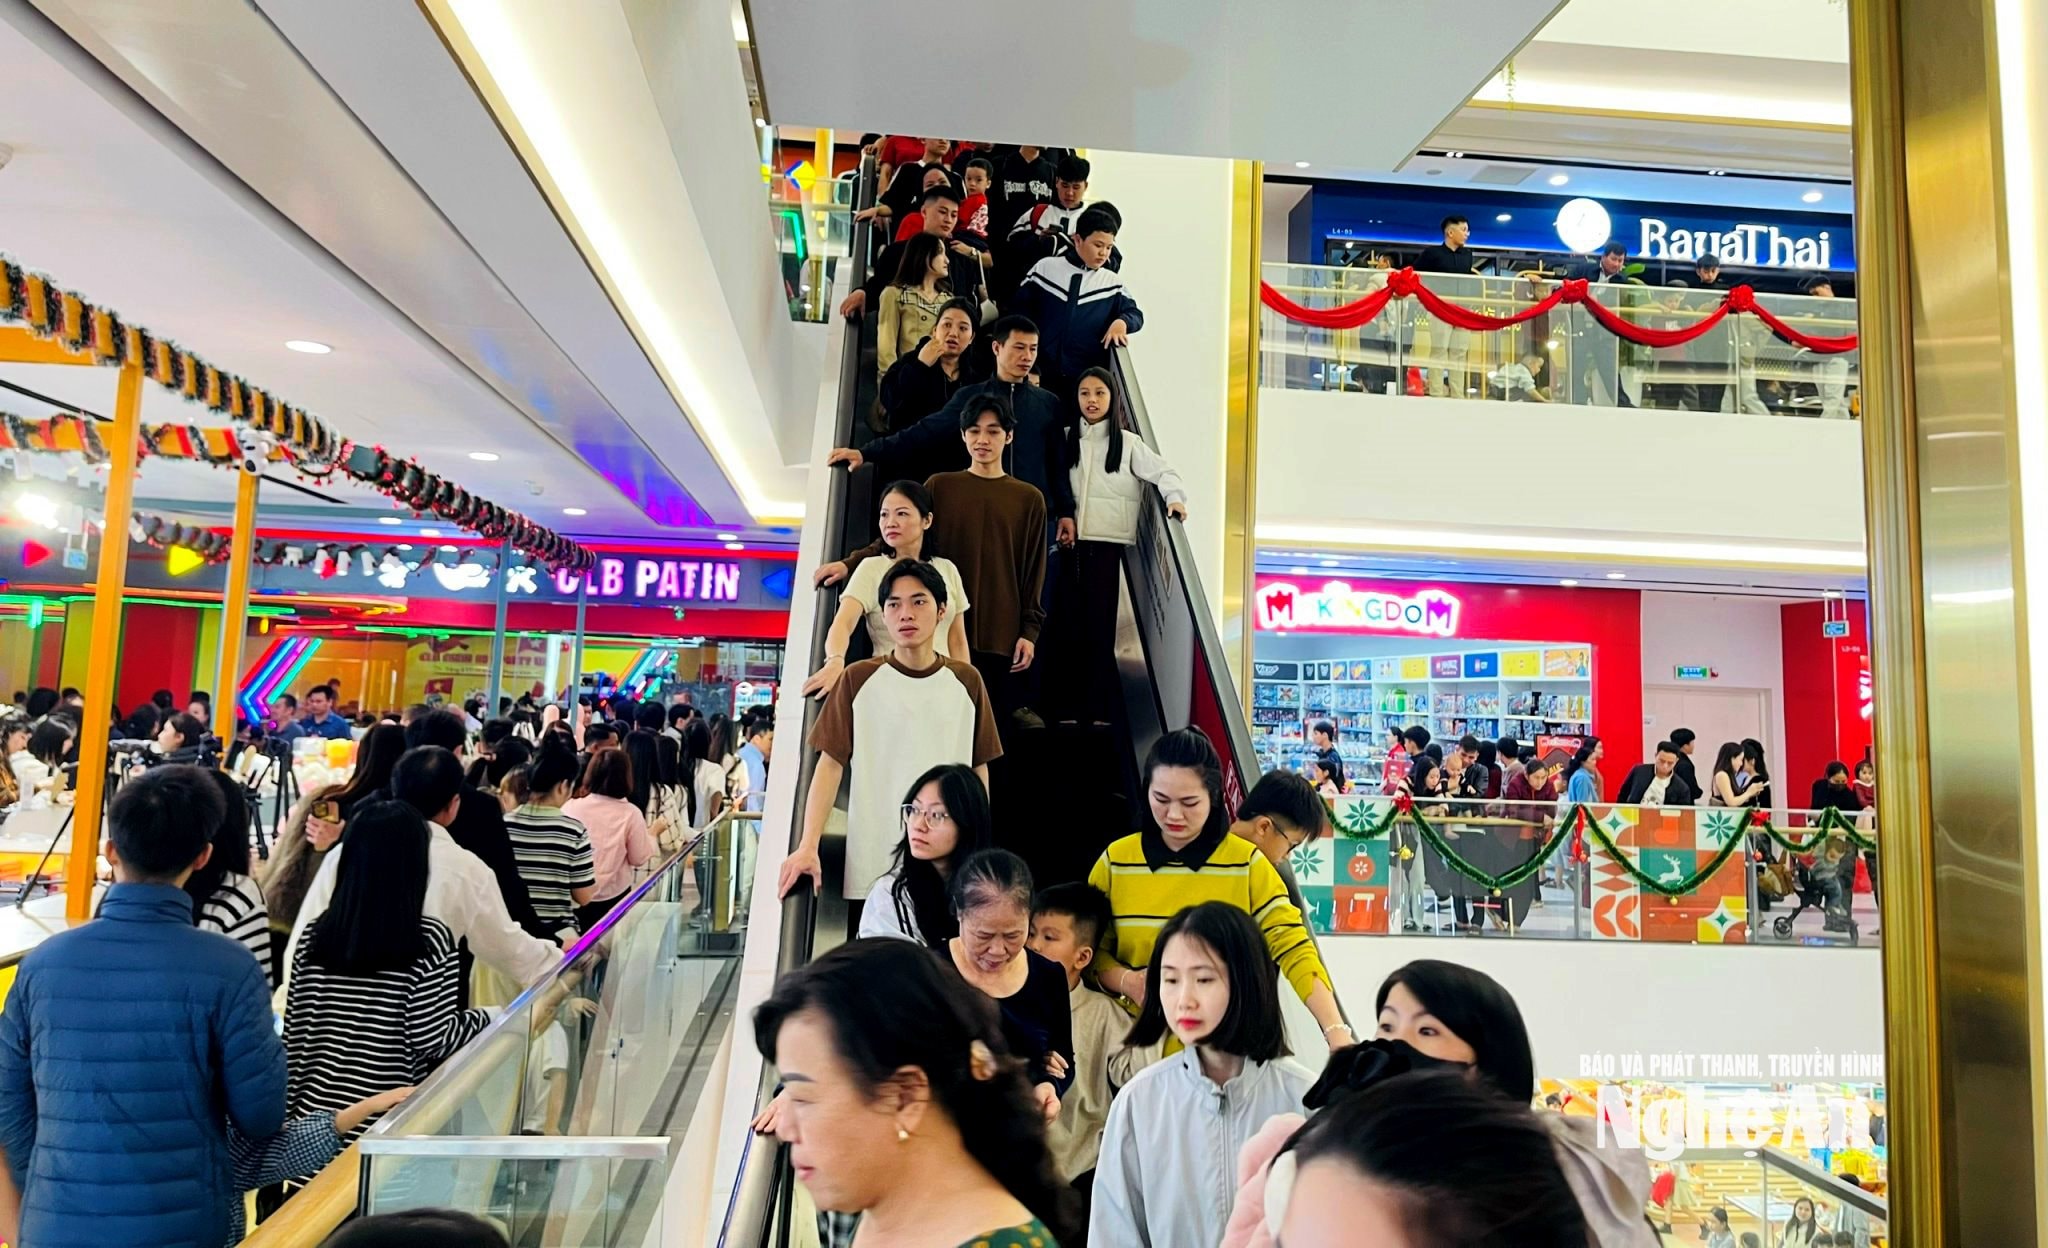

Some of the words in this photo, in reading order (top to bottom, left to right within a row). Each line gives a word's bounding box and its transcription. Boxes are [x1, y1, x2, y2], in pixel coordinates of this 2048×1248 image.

[556, 558, 625, 597] CLB
[635, 559, 741, 601] PATIN
[1262, 586, 1456, 632] MKNGDOM
